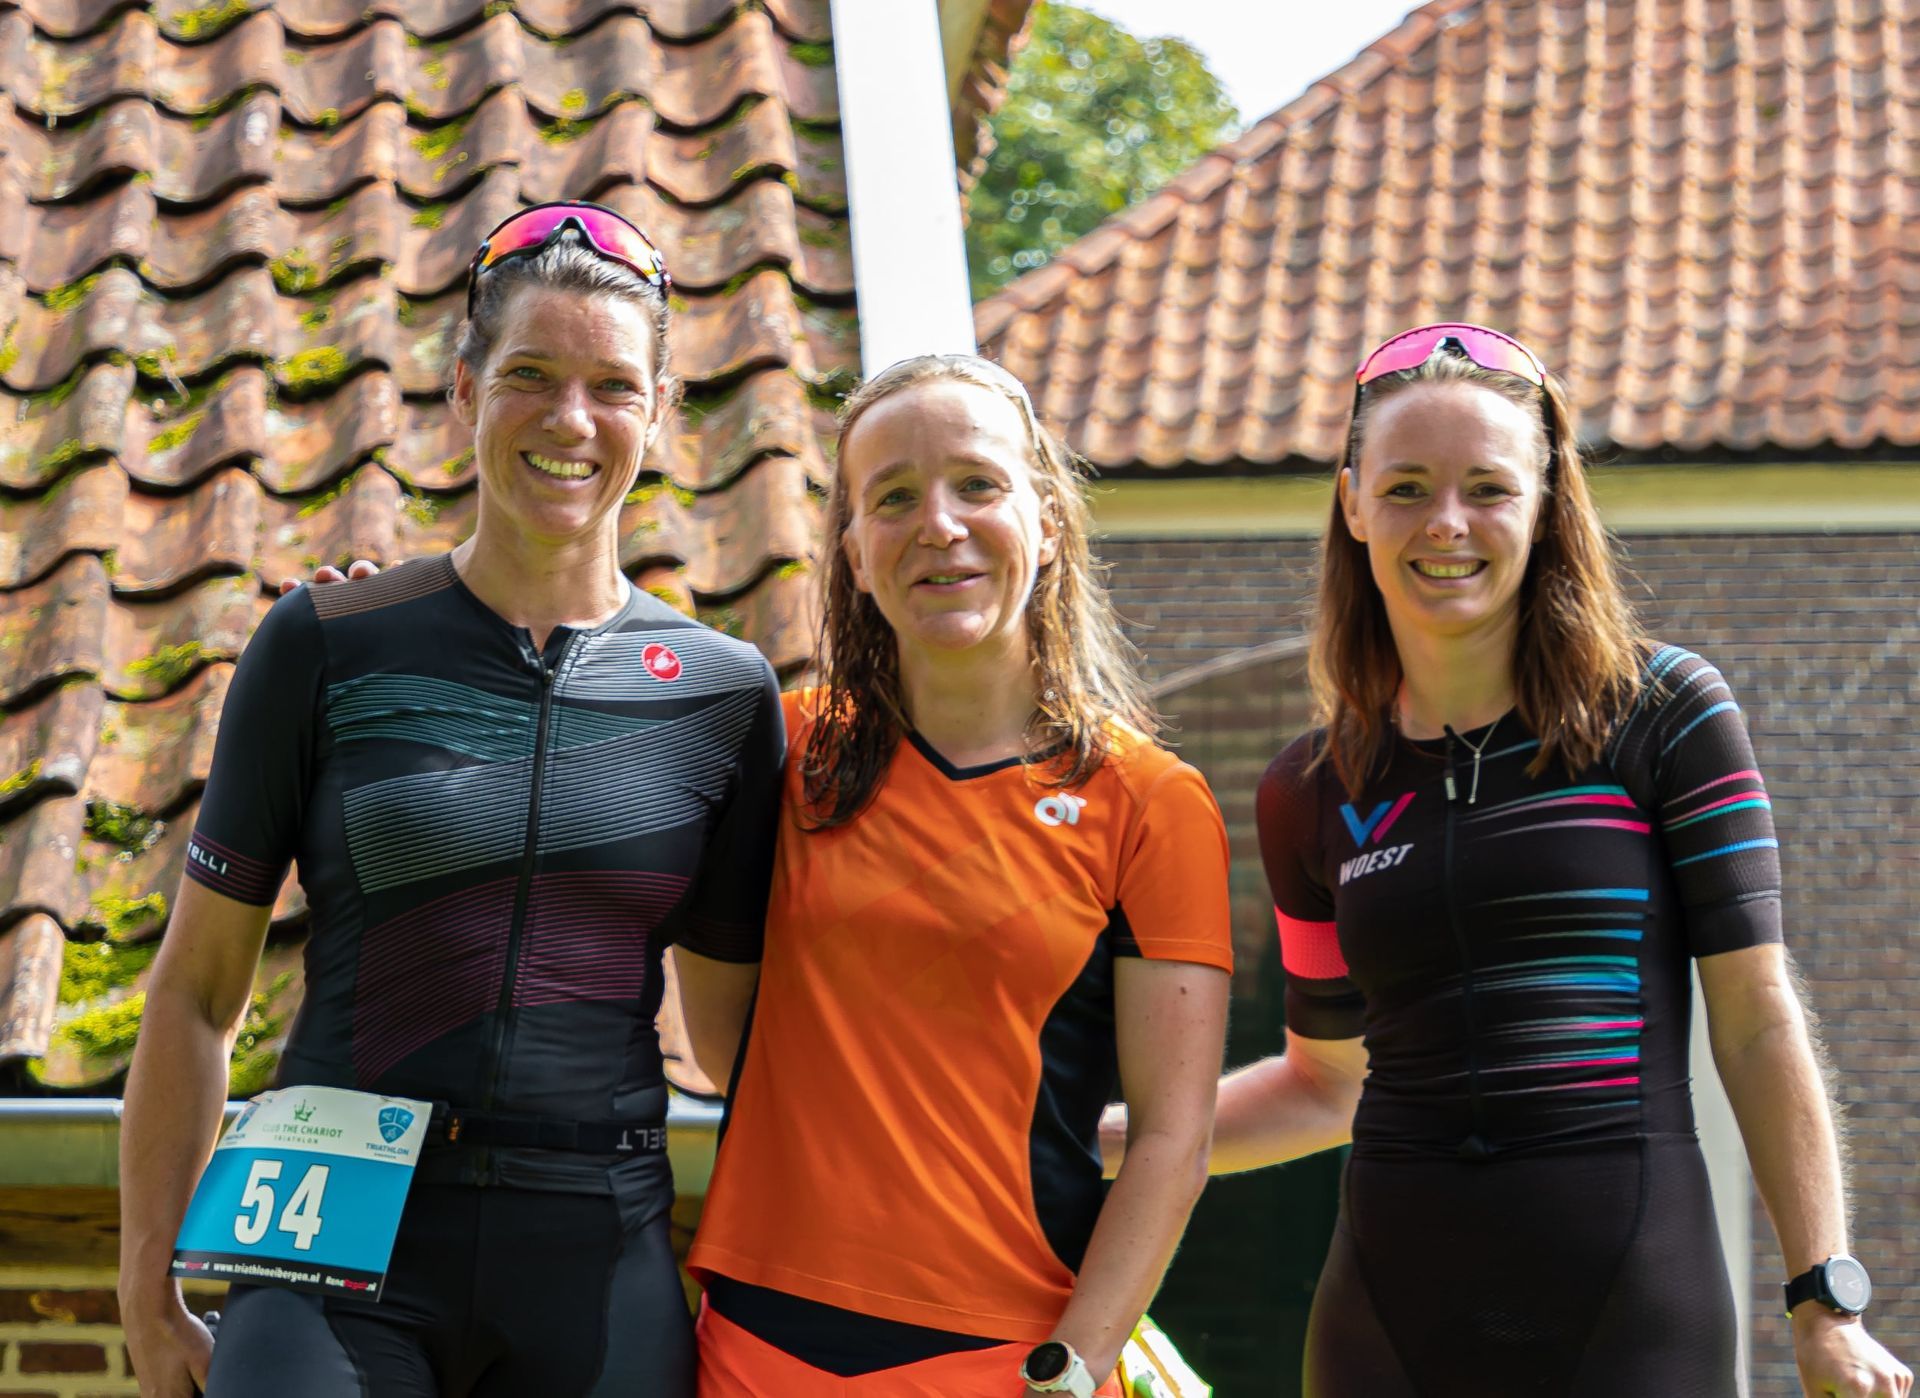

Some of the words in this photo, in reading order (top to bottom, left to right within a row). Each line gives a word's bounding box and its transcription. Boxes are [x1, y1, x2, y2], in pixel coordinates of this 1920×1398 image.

[1339, 843, 1415, 886] WOEST
[282, 1123, 299, 1134] THE
[300, 1125, 343, 1138] CHARIOT
[365, 1142, 410, 1156] TRIATHLON
[233, 1159, 330, 1251] 54
